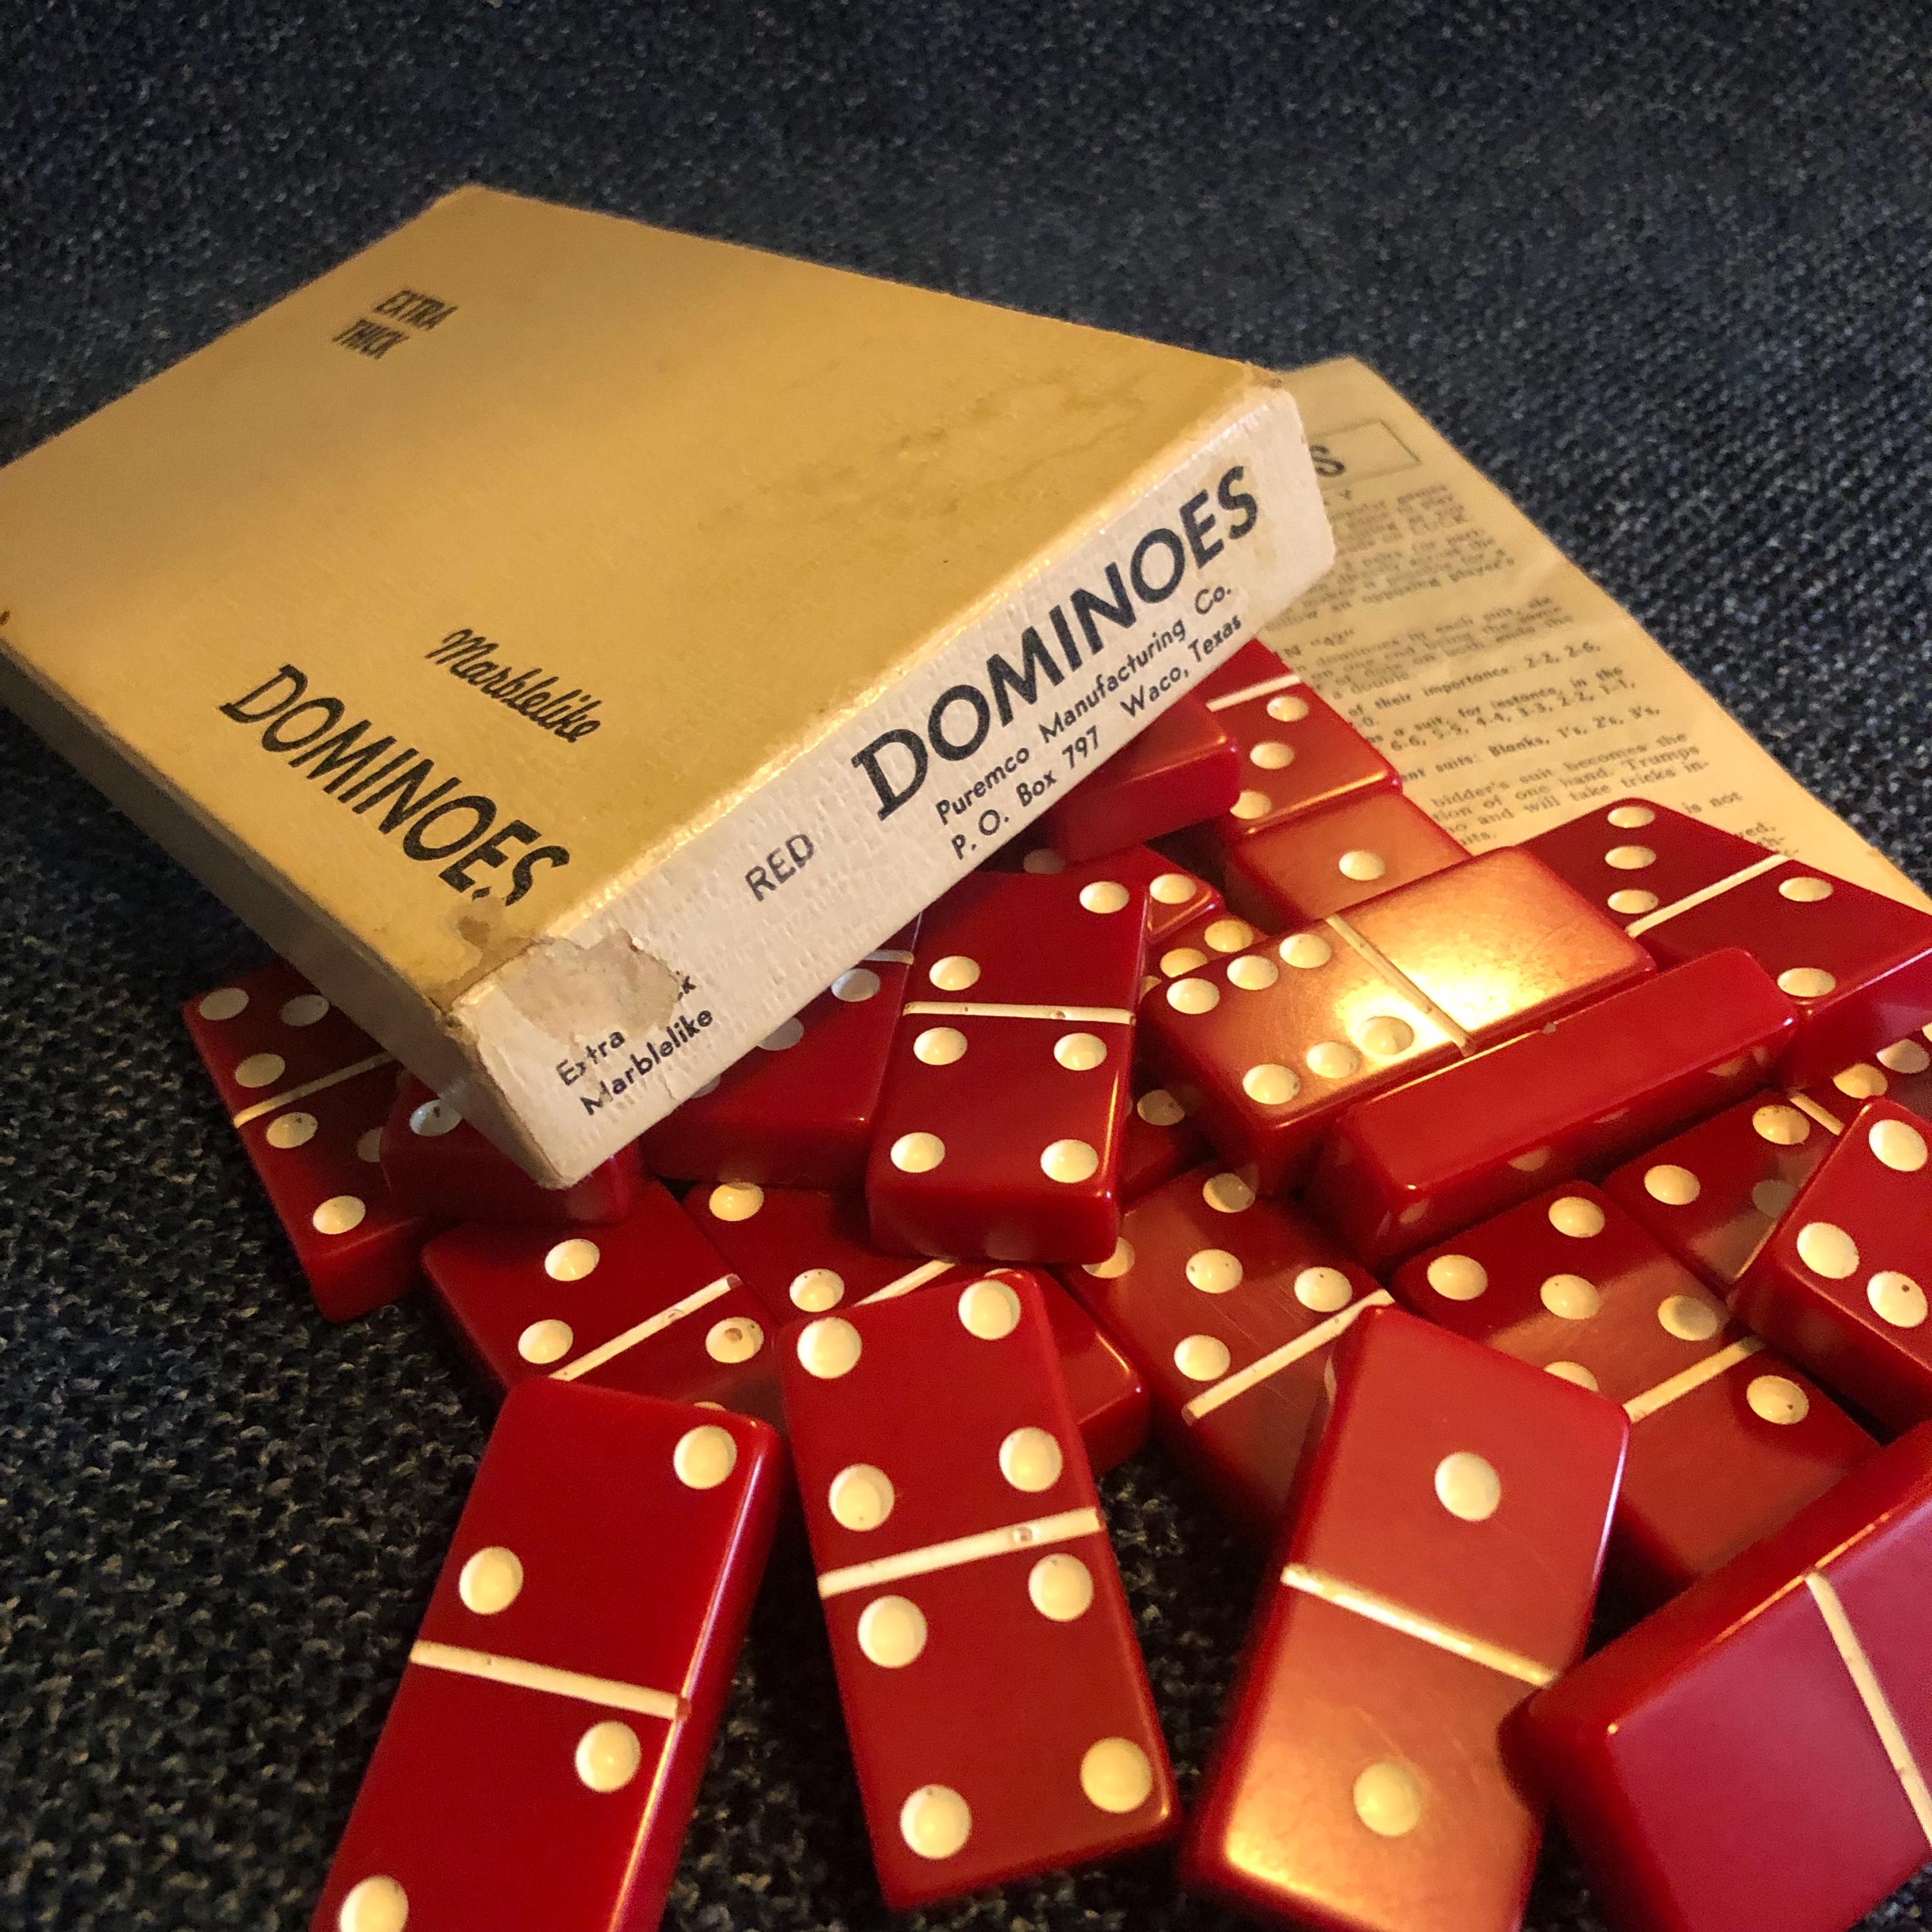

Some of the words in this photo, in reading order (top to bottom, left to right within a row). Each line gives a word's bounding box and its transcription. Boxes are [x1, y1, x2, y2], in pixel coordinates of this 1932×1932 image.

[331, 317, 410, 359] THICK
[373, 288, 458, 330] EXTRA
[426, 628, 601, 743] Marblelike
[851, 466, 1258, 821] DOMINOES
[937, 748, 1030, 825] Puremco
[1039, 619, 1186, 744] Manufacturing
[1195, 585, 1231, 616] Co.
[952, 835, 976, 860] P.
[979, 810, 1010, 835] O.
[1016, 770, 1057, 807] Box
[1061, 726, 1101, 770] 797
[1120, 665, 1189, 717] Waco,
[1188, 616, 1242, 664] Texas
[218, 663, 570, 907] DOMINOES
[745, 834, 815, 902] RED
[556, 1031, 625, 1086] Extra
[580, 1010, 713, 1115] Marblelike
